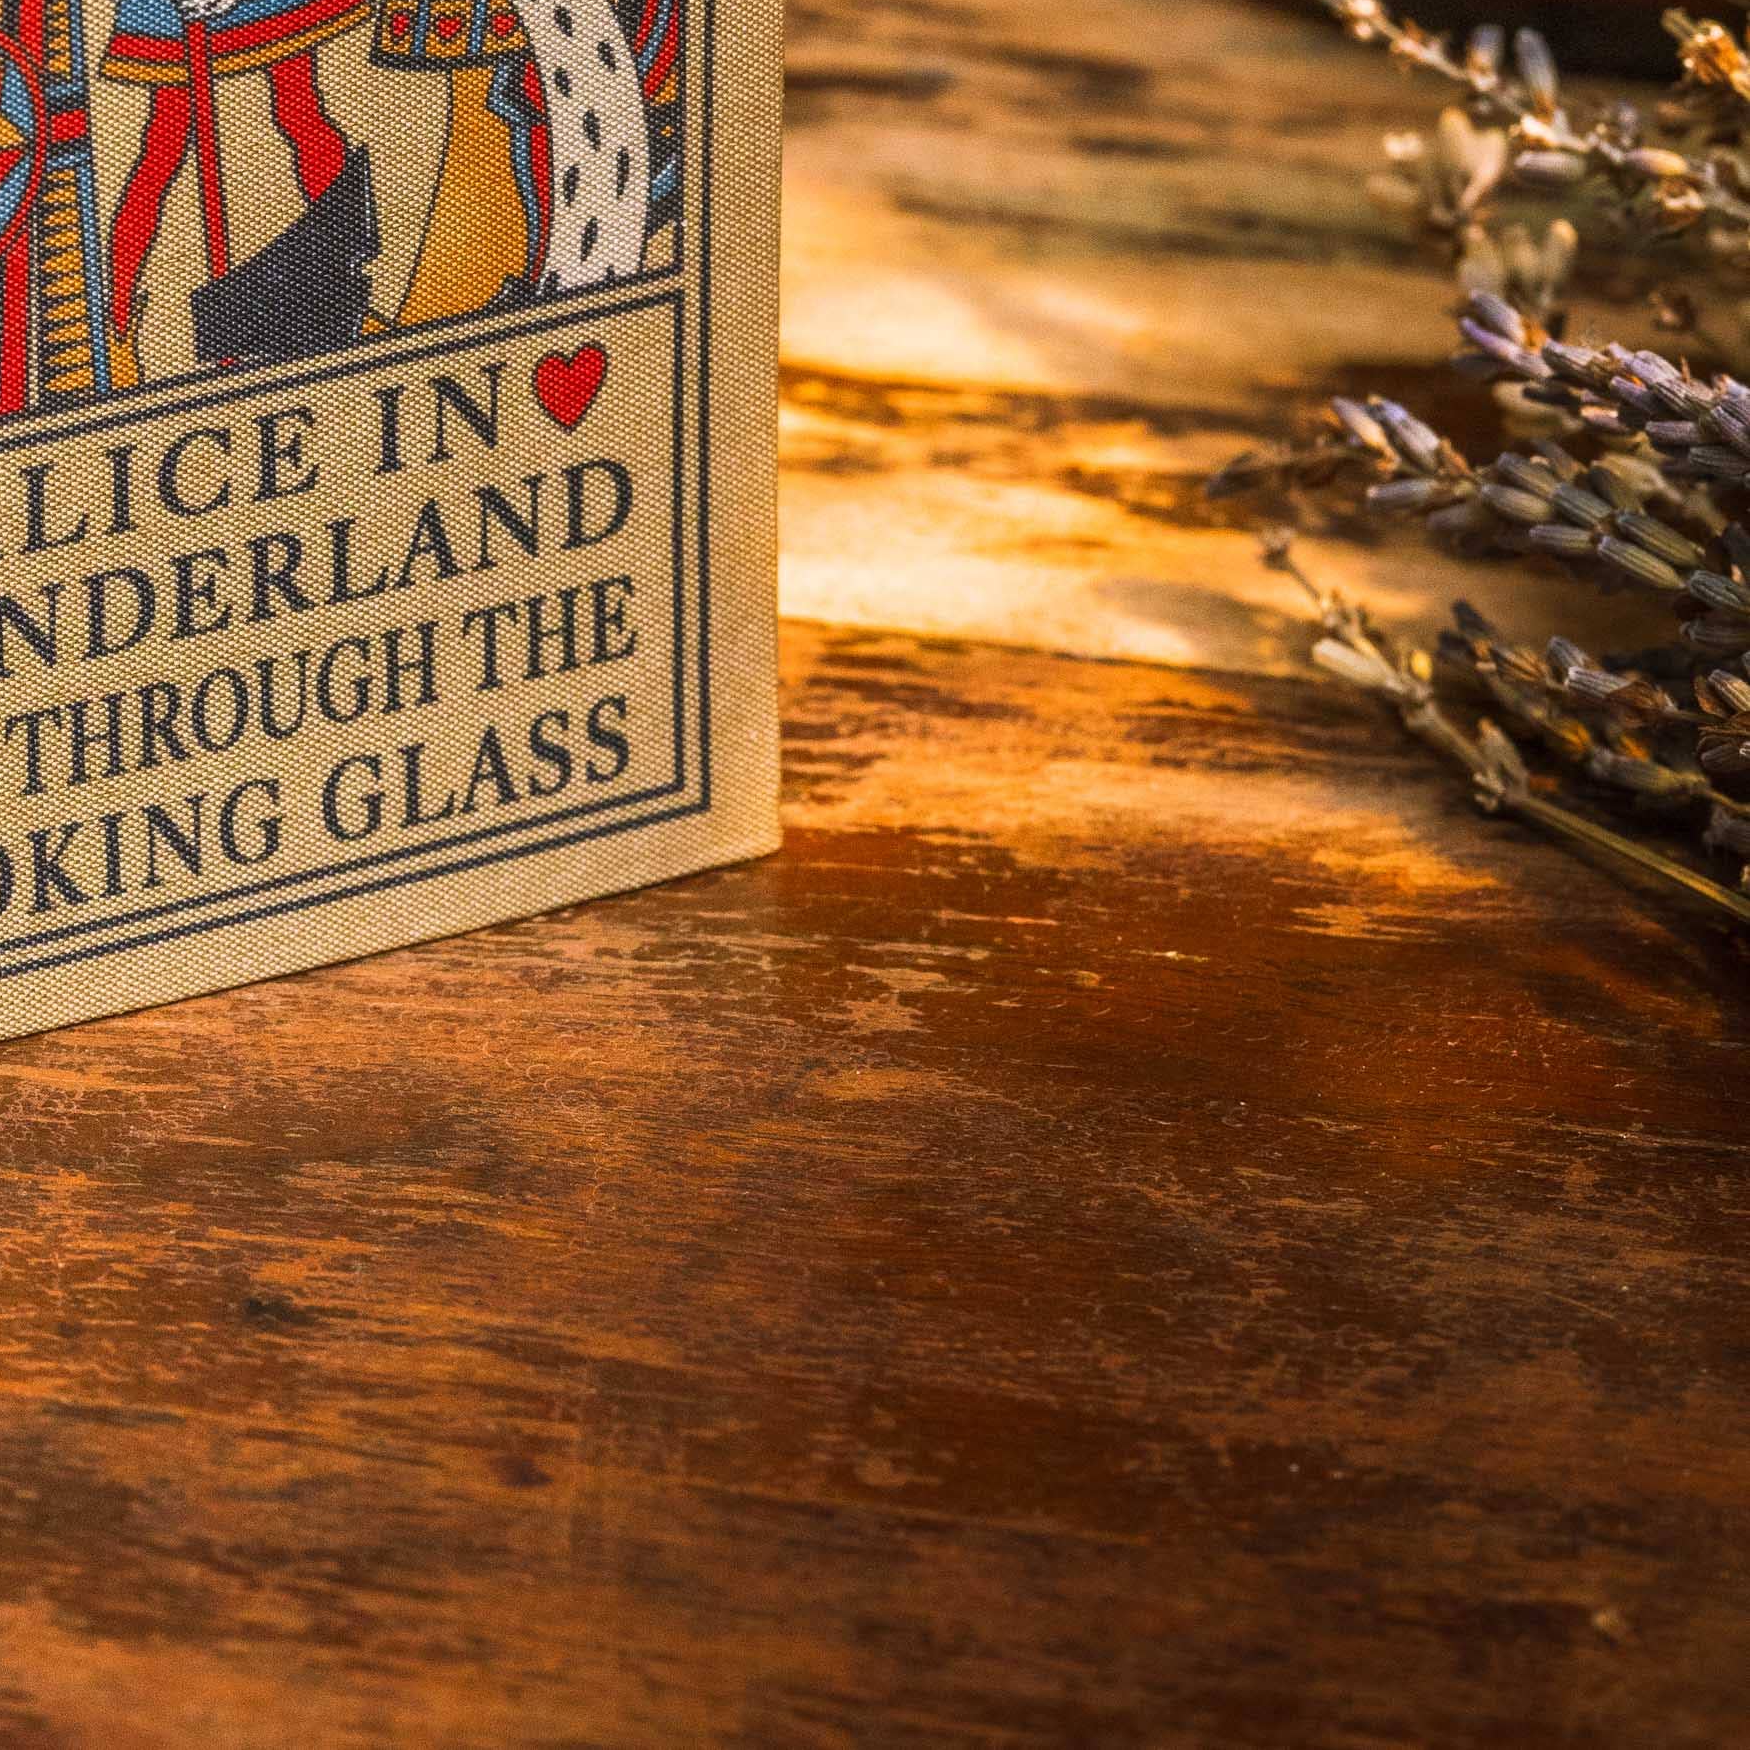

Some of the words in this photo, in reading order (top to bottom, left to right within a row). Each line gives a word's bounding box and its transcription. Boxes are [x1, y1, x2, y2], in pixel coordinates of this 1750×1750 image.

[373, 362, 508, 475] IN
[5, 621, 439, 795] THROUGH
[462, 574, 637, 692] THE
[322, 694, 629, 842] GLASS
